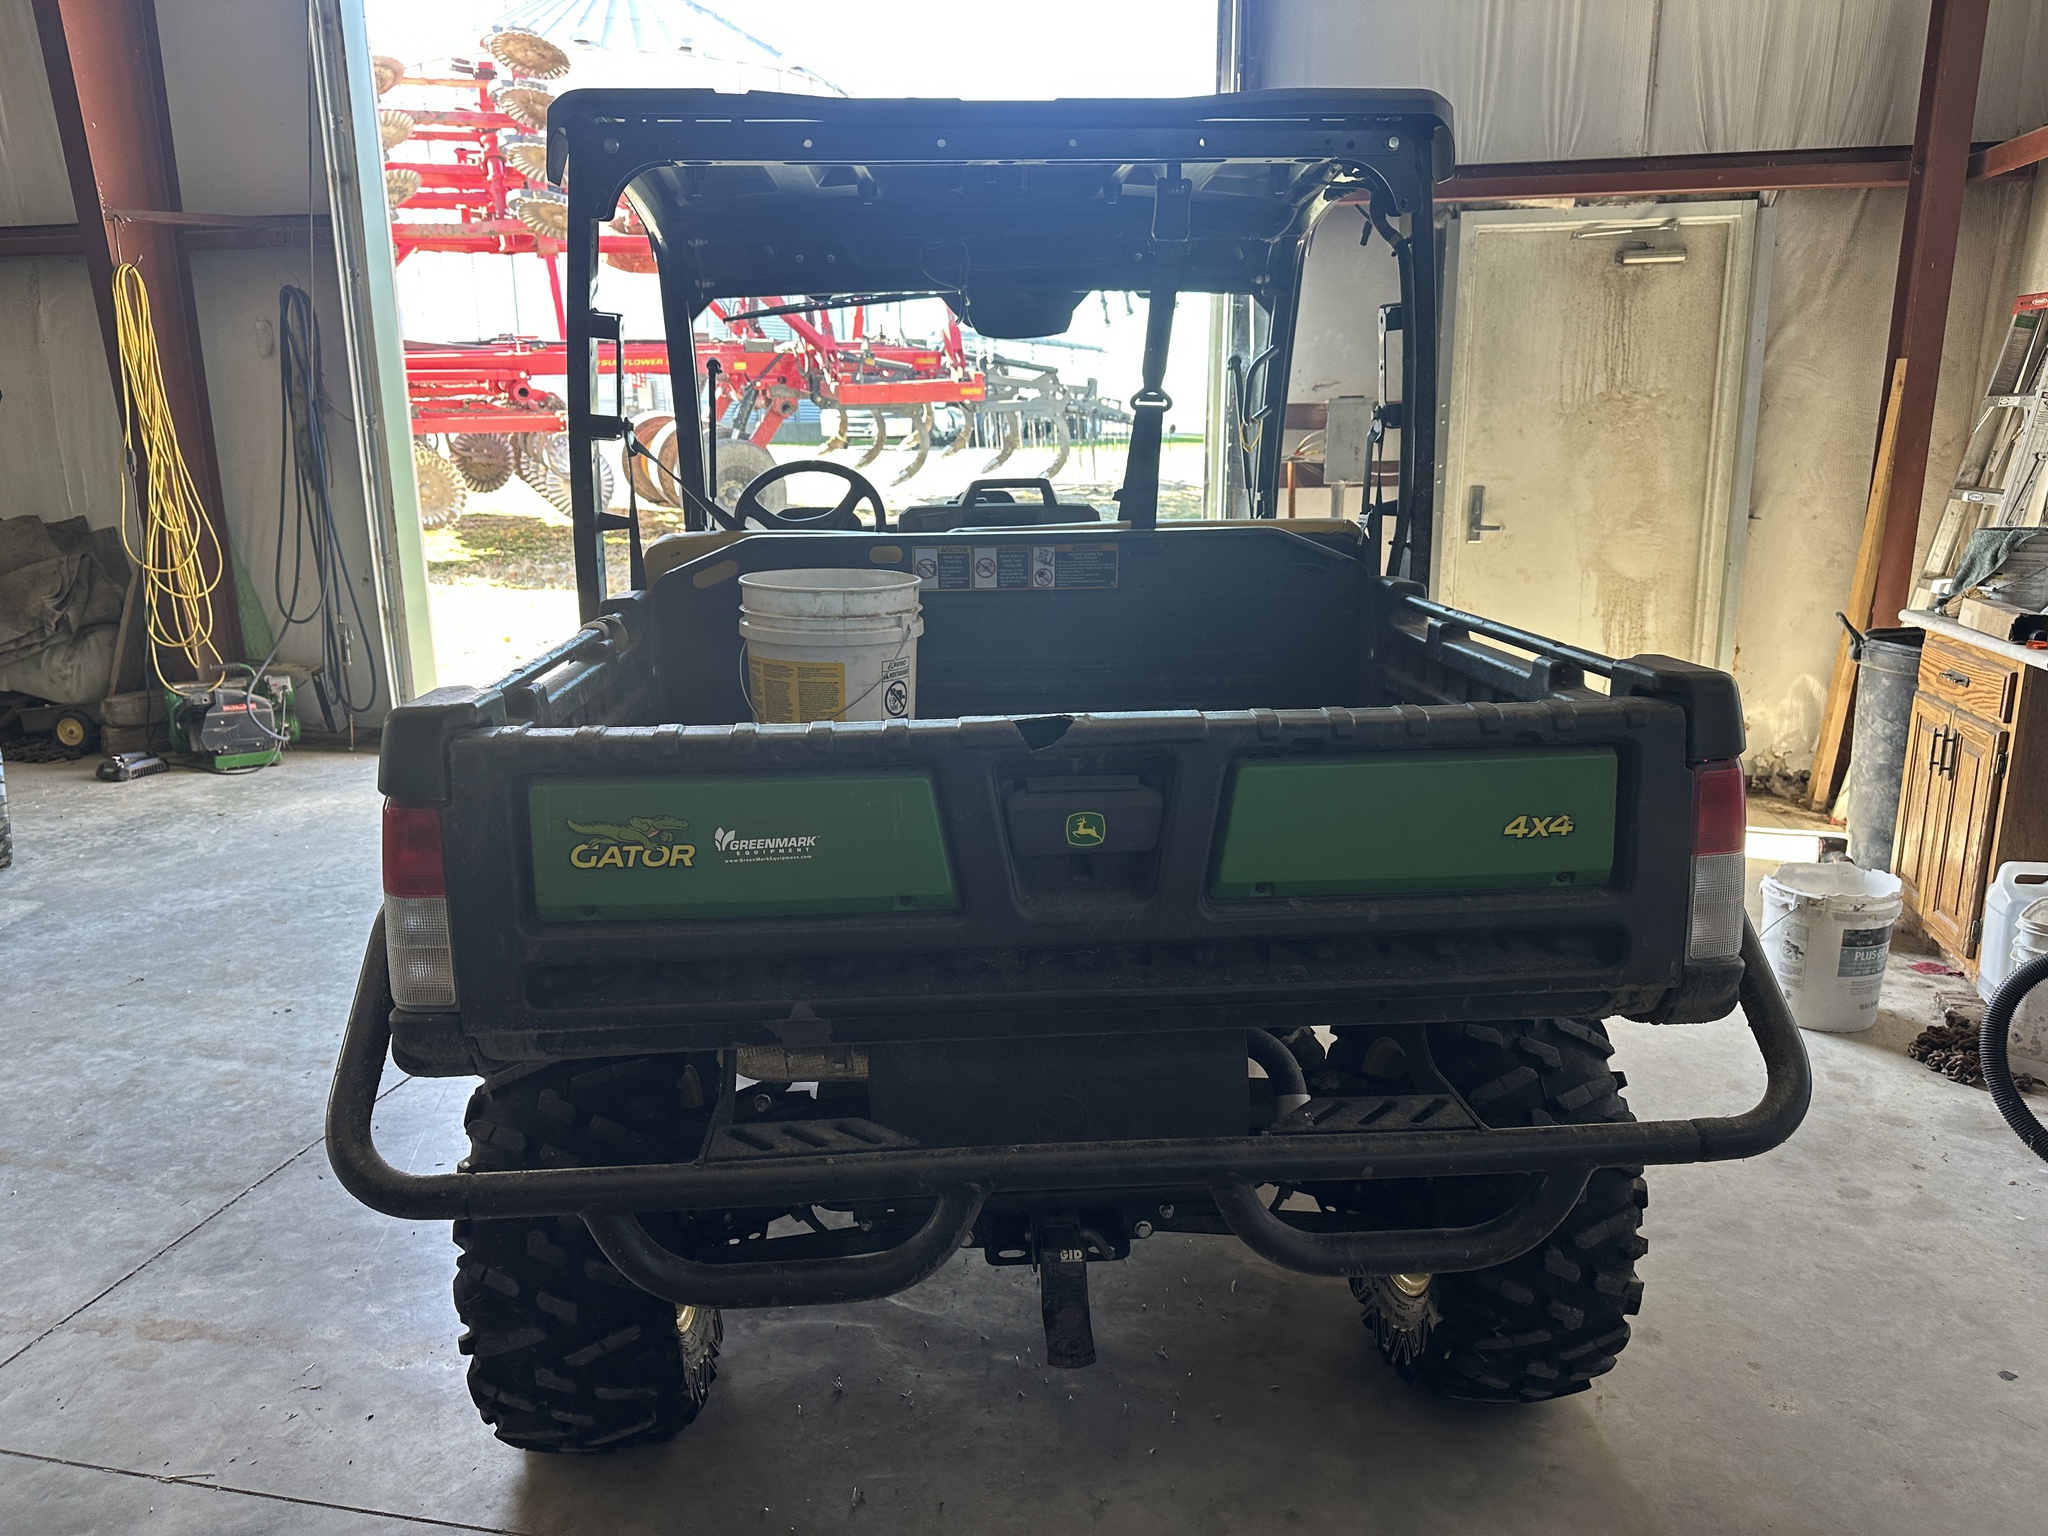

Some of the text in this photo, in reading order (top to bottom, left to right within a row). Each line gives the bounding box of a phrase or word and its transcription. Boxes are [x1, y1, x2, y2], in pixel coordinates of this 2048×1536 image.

[601, 358, 664, 367] SUFLOWER
[730, 836, 817, 850] GREENMARK
[570, 843, 697, 869] GATOR
[736, 847, 810, 856] EQUIPMENT
